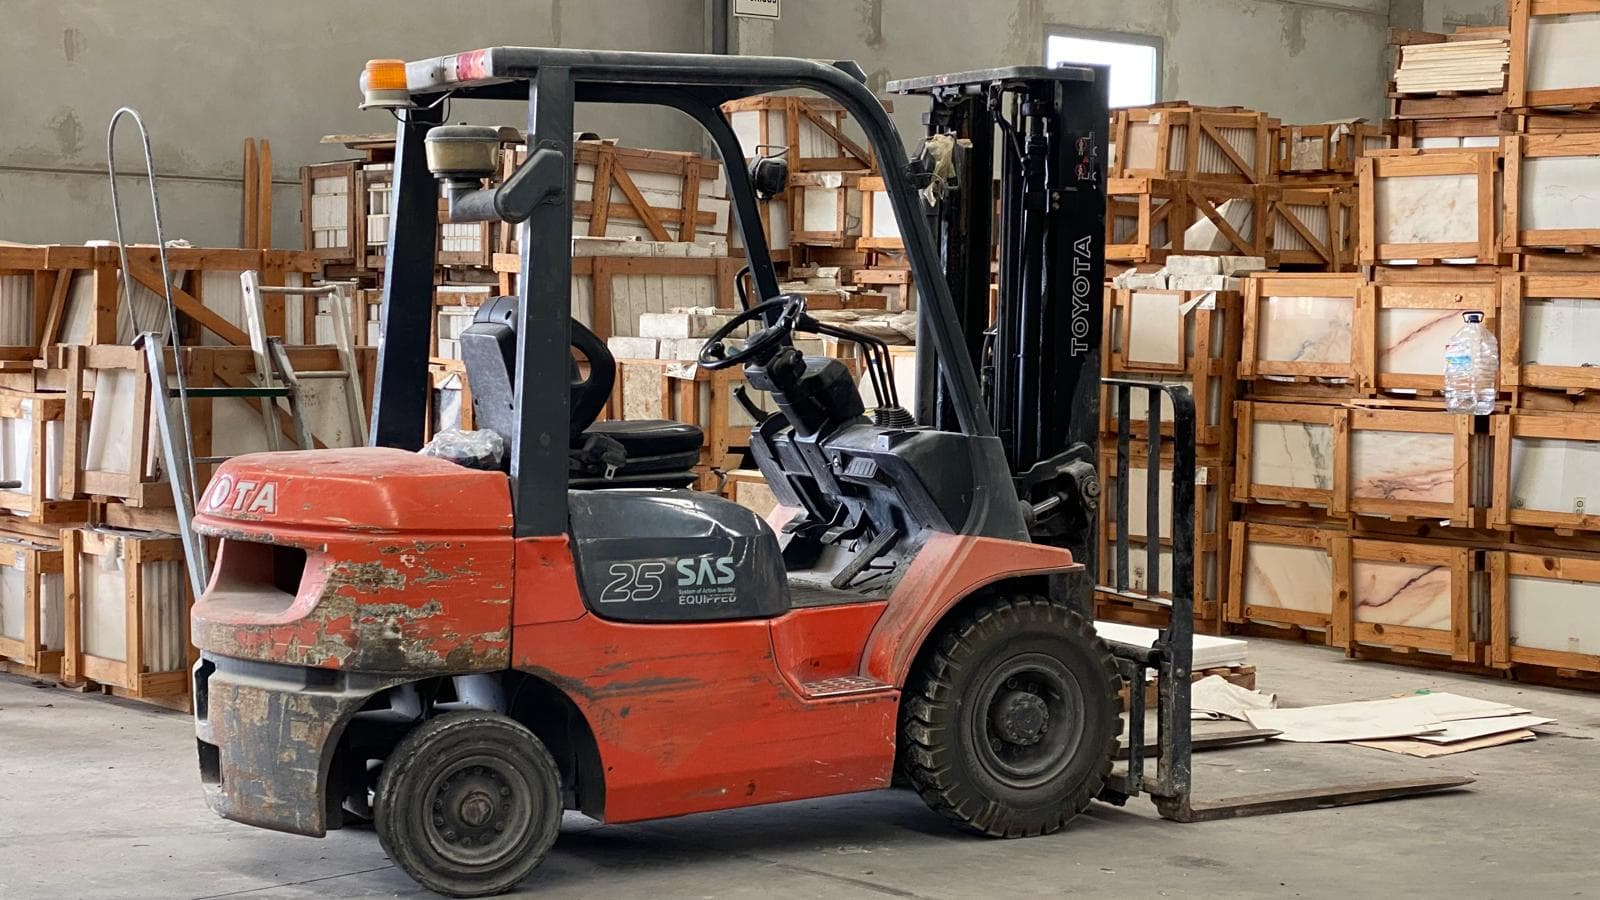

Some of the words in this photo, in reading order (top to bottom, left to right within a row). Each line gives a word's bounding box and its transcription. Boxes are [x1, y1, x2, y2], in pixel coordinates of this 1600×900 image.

[1071, 235, 1091, 356] TOYOTA
[599, 562, 666, 602] 25
[676, 556, 736, 586] SAS
